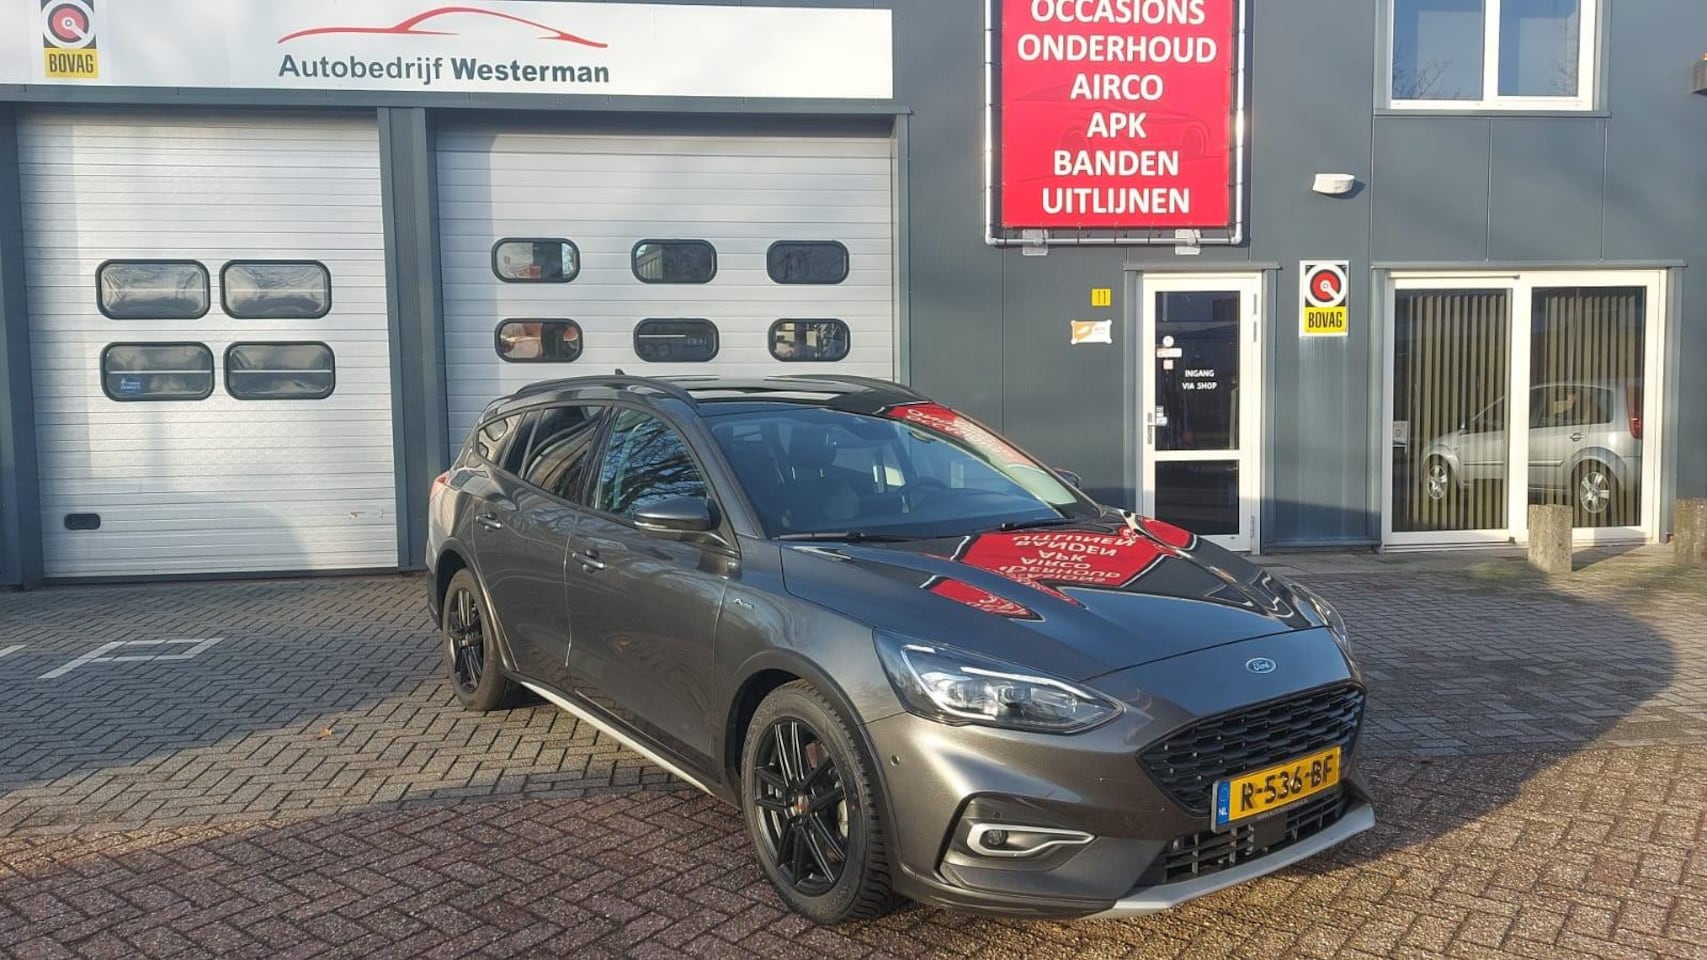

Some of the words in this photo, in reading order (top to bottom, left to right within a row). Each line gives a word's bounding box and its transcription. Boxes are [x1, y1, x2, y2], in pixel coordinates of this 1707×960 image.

[1030, 0, 1206, 24] OCCASIONS
[1017, 33, 1218, 63] ONDERHOUD
[48, 53, 94, 73] BOVAG
[278, 54, 443, 85] Autobedrijf
[450, 57, 610, 84] Westerman
[1070, 73, 1164, 101] AIRCO
[1086, 112, 1147, 138] APK
[1053, 149, 1180, 176] BANDEN
[1042, 187, 1190, 214] UITLIJNEN
[1308, 310, 1343, 328] BOVAG
[1182, 382, 1195, 390] VIA
[1196, 382, 1217, 390] SHOP
[1184, 369, 1215, 378] INGANG
[1240, 755, 1333, 811] R-536-BF
[1218, 807, 1227, 816] NL
